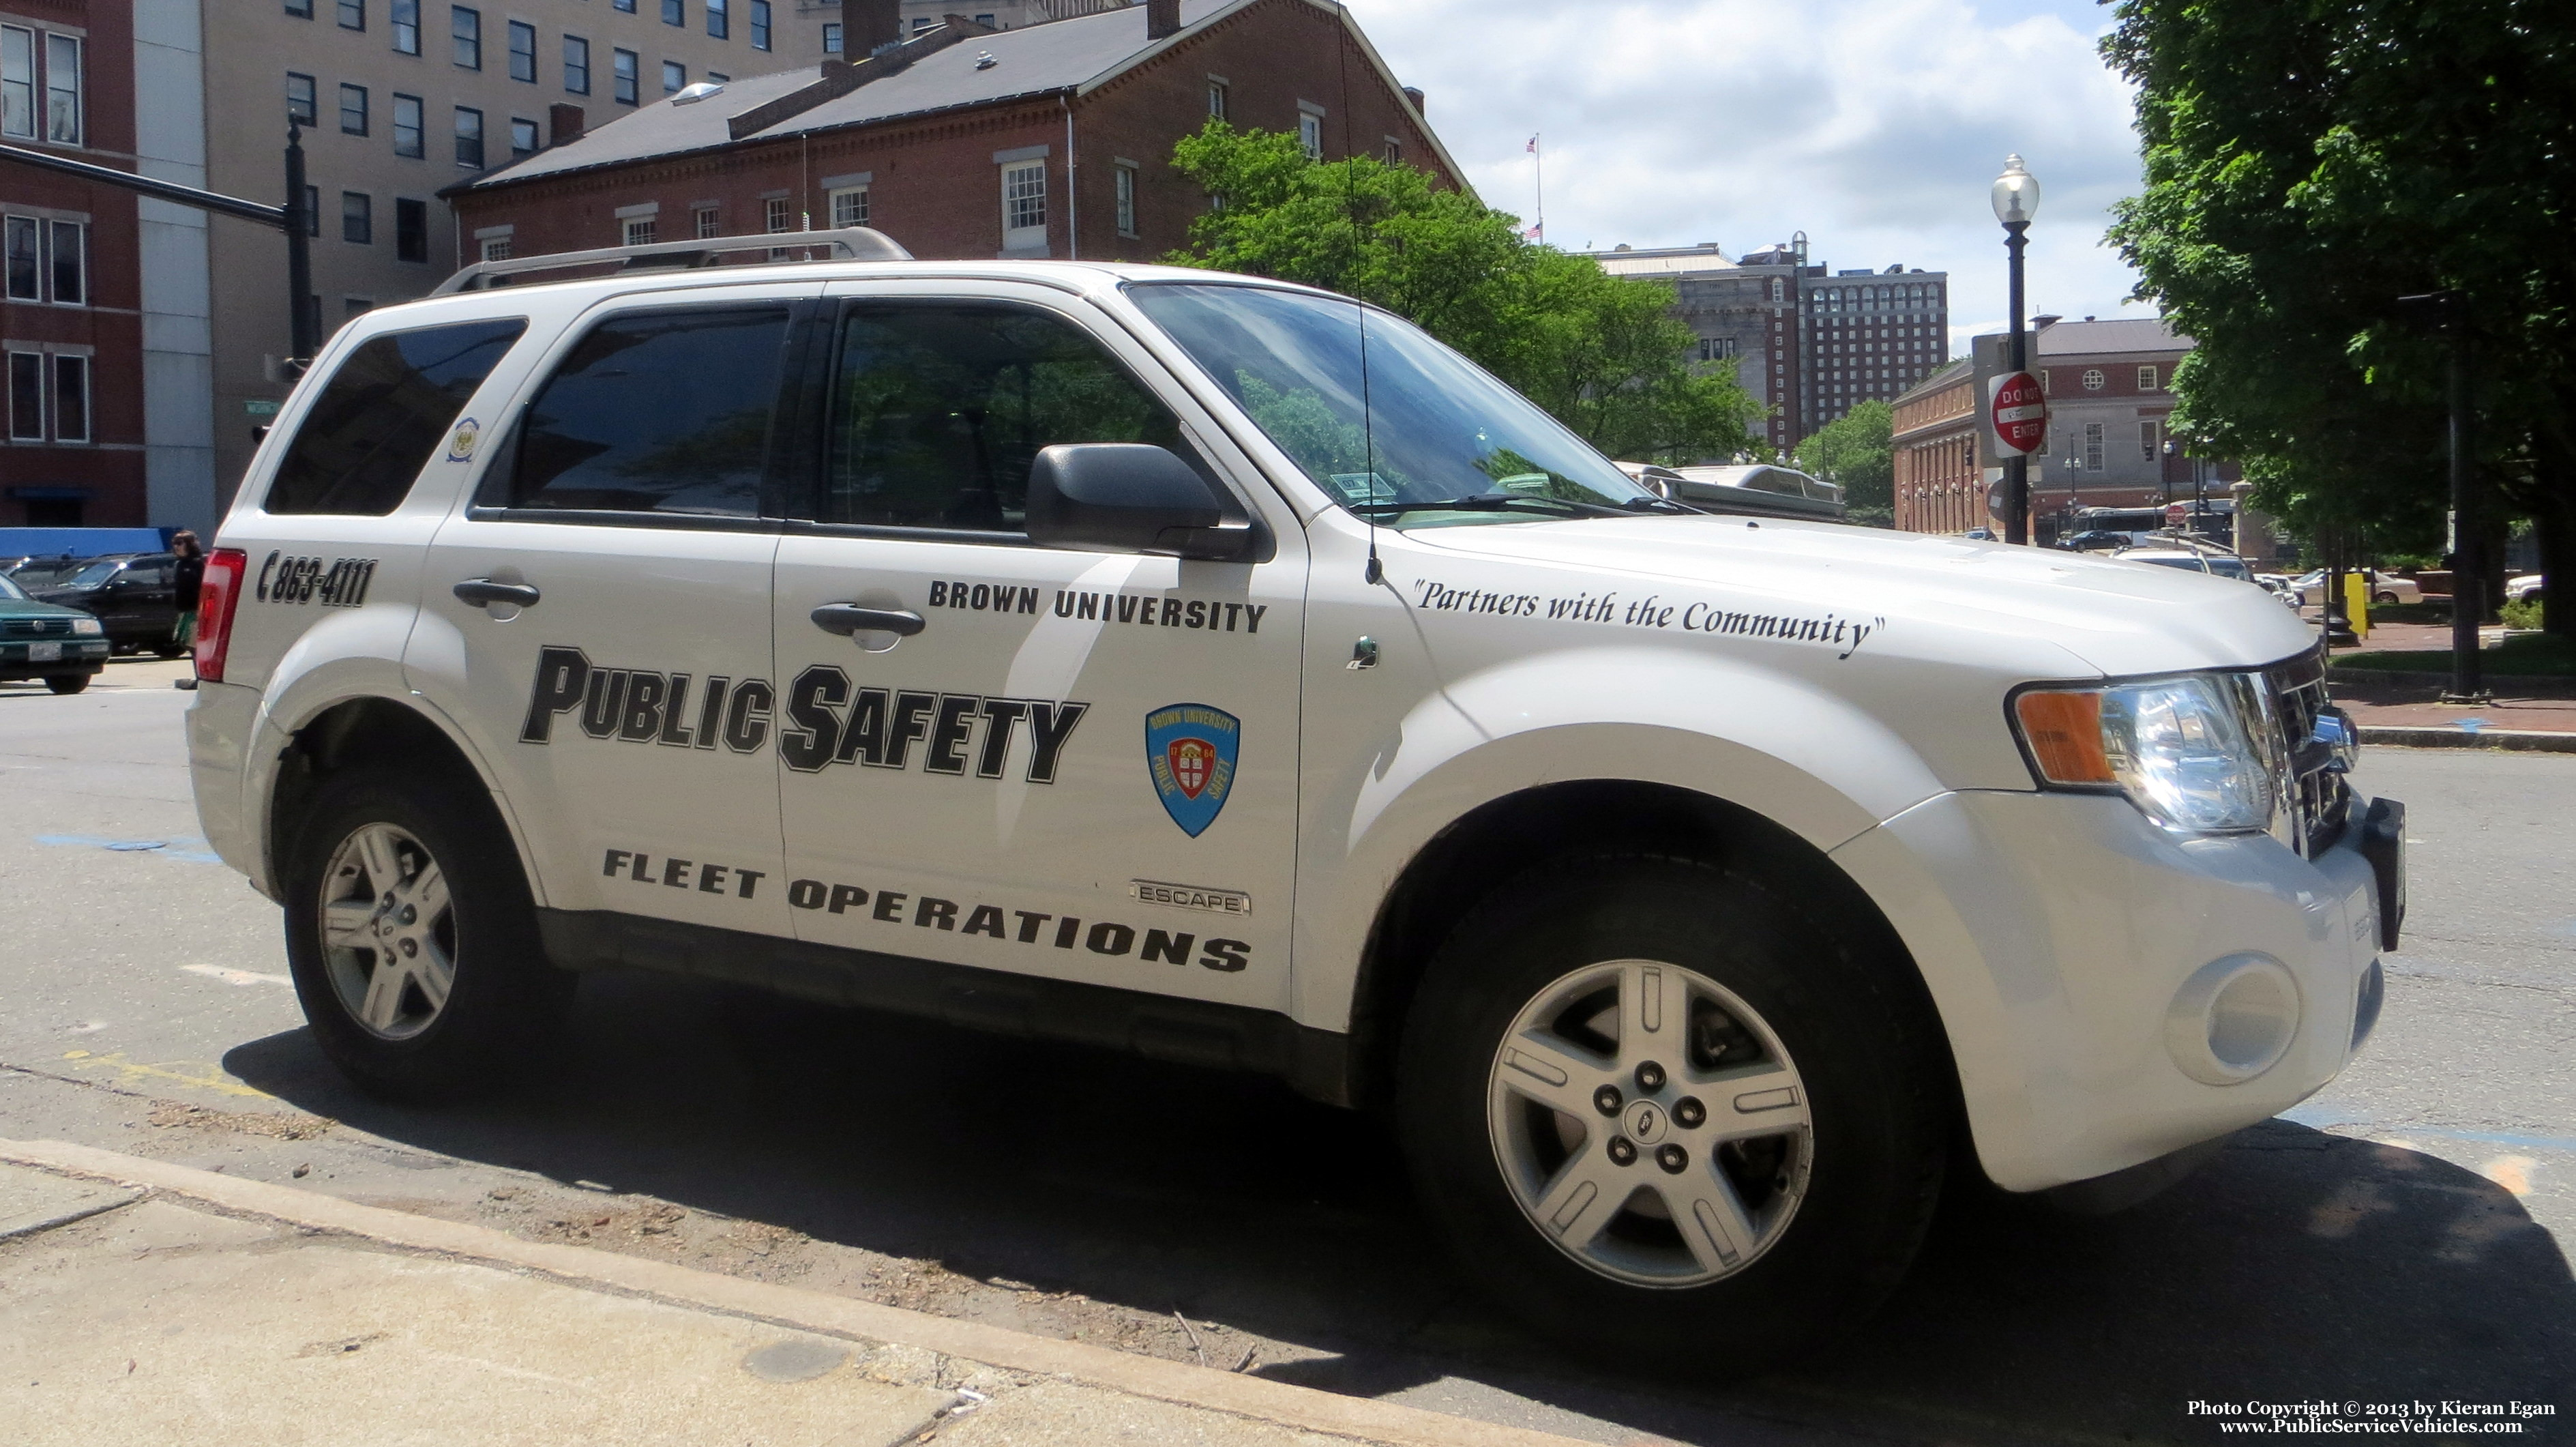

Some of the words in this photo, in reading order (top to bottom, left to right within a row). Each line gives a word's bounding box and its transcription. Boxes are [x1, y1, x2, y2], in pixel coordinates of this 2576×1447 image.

[2002, 389, 2022, 404] DO
[2024, 386, 2039, 400] NOT
[2011, 423, 2040, 439] ENTER
[271, 555, 380, 608] 863-4111
[928, 580, 1040, 614] BROWN
[1054, 590, 1268, 633] UNIVERSITY
[1414, 577, 1538, 616] "Partners
[1548, 591, 1617, 624] with
[1625, 594, 1674, 629] the
[1682, 601, 1887, 660] Community"
[518, 645, 775, 755] PUBLIC
[778, 664, 1091, 785] SAFETY
[1150, 710, 1183, 730] BROWN
[1184, 709, 1236, 733] UNIVERSITY
[1153, 755, 1176, 796] PUBLIC
[1207, 757, 1231, 800] SAFETY
[602, 848, 767, 900] FLEET
[787, 877, 1252, 974] OPERATIONS
[1140, 886, 1241, 912] ESCAPE
